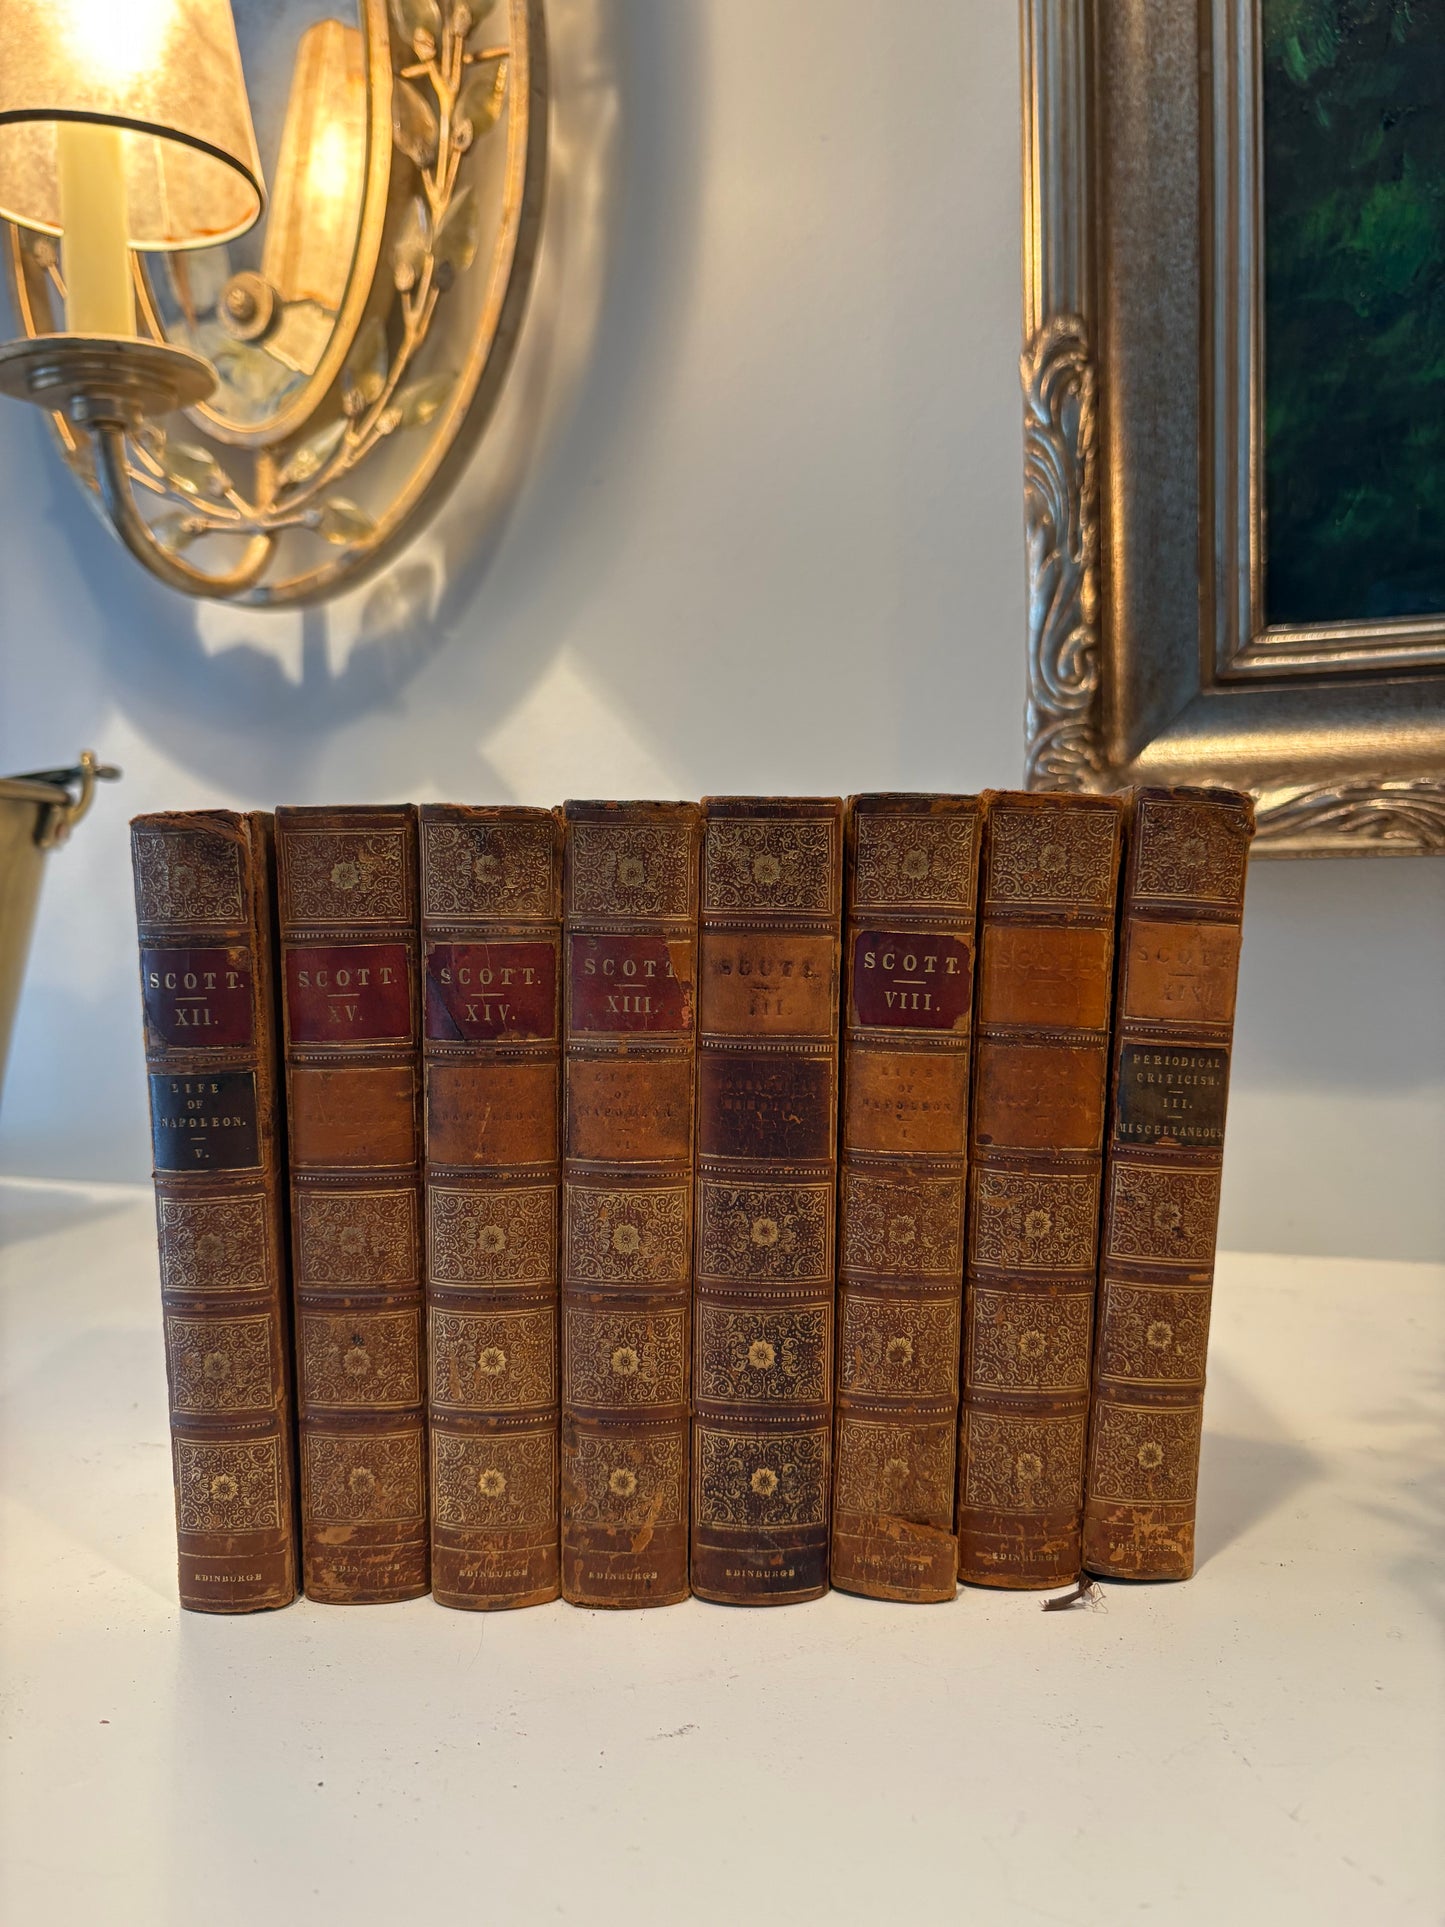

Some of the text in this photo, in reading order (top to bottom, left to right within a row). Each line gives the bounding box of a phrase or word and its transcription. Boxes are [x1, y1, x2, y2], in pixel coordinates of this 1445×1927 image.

[864, 952, 961, 974] SCOTT.
[150, 972, 244, 989] SCOTT.
[297, 967, 398, 987] SCOTT.
[440, 967, 541, 985] SCOTT.
[606, 996, 659, 1013] XIII.
[884, 991, 941, 1012] VIII.
[175, 1008, 219, 1025] XII.
[465, 1004, 516, 1022] XIV.
[1133, 1054, 1220, 1068] PERIODICAL
[1136, 1073, 1220, 1086] CRITICISM.
[171, 1083, 219, 1094] LIFE
[187, 1100, 203, 1110] OF
[1163, 1098, 1193, 1109] III.
[161, 1116, 247, 1128] NAPOLEON.
[195, 1149, 210, 1158] V.
